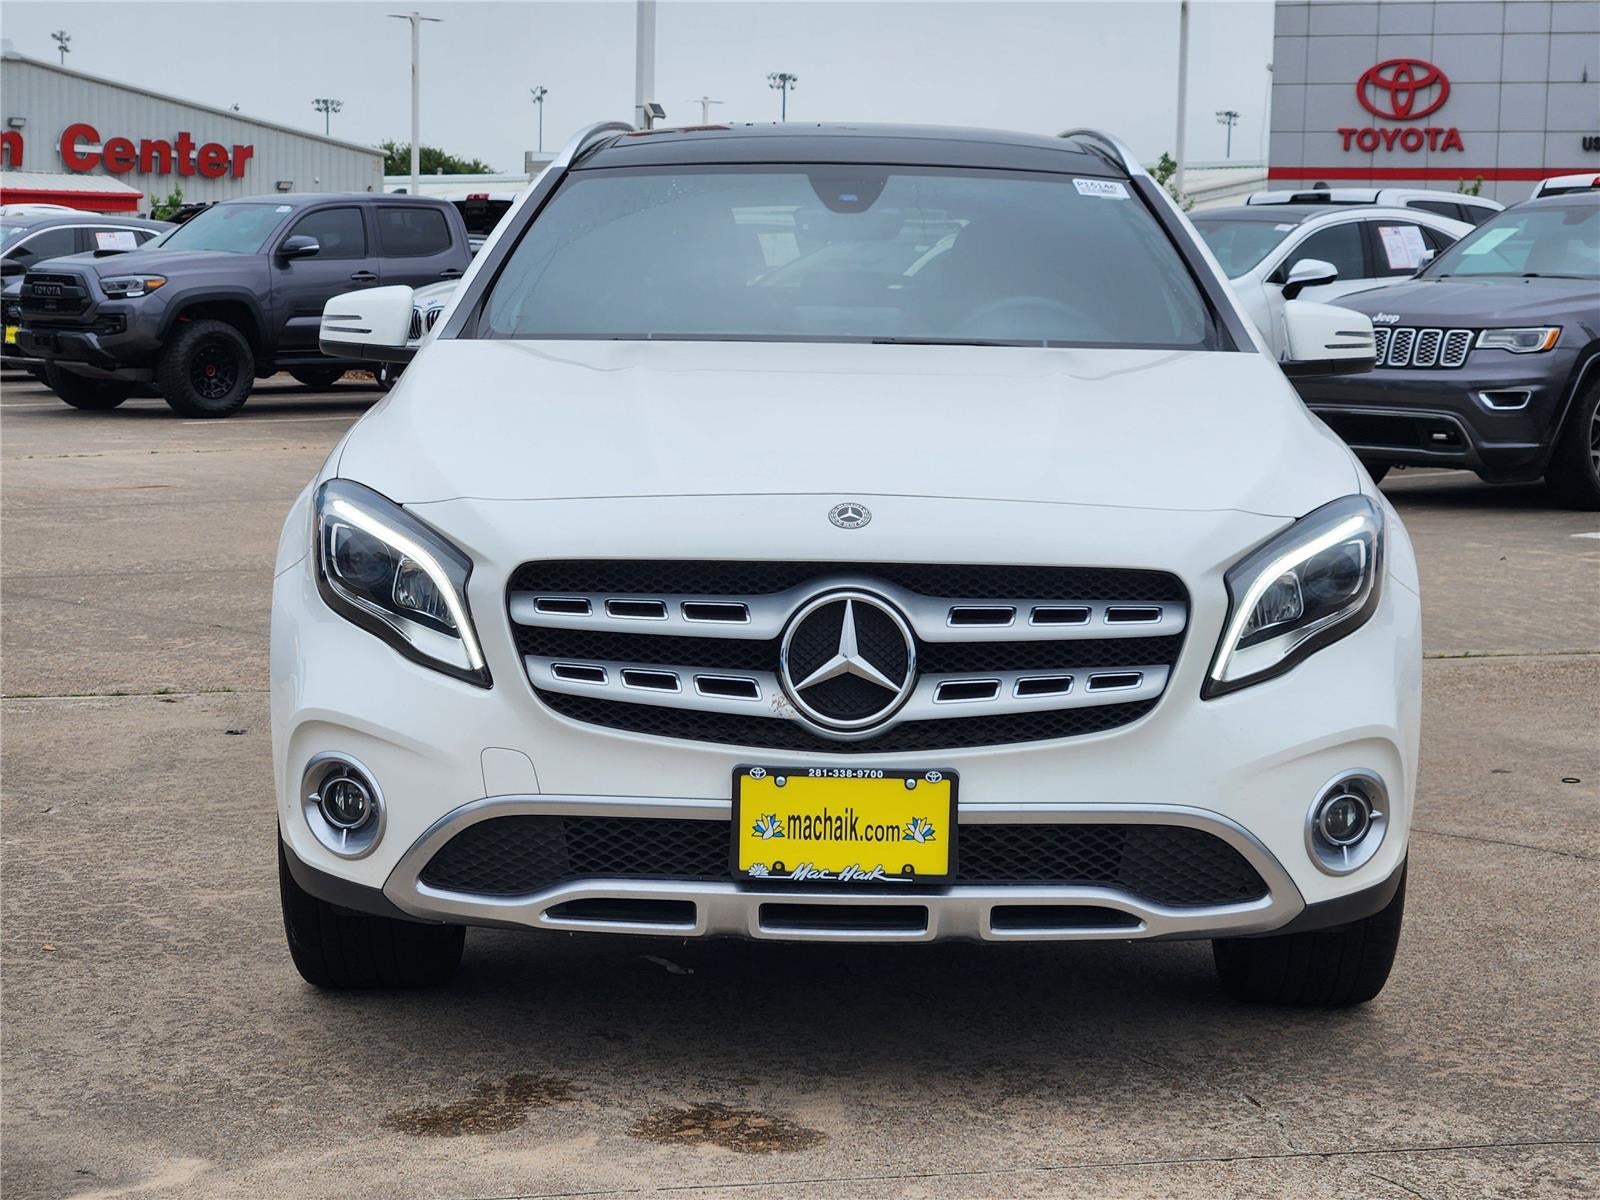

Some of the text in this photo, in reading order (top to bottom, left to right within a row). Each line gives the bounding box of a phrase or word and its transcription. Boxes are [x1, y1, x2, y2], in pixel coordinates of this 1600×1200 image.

[1338, 128, 1464, 152] TOYOTA
[60, 123, 254, 178] Center
[33, 285, 62, 296] TOYOTA
[1372, 312, 1400, 325] Jeep
[808, 768, 884, 778] 281-338-9700
[787, 807, 901, 842] machaik.com
[792, 863, 886, 882] Mac Haik
